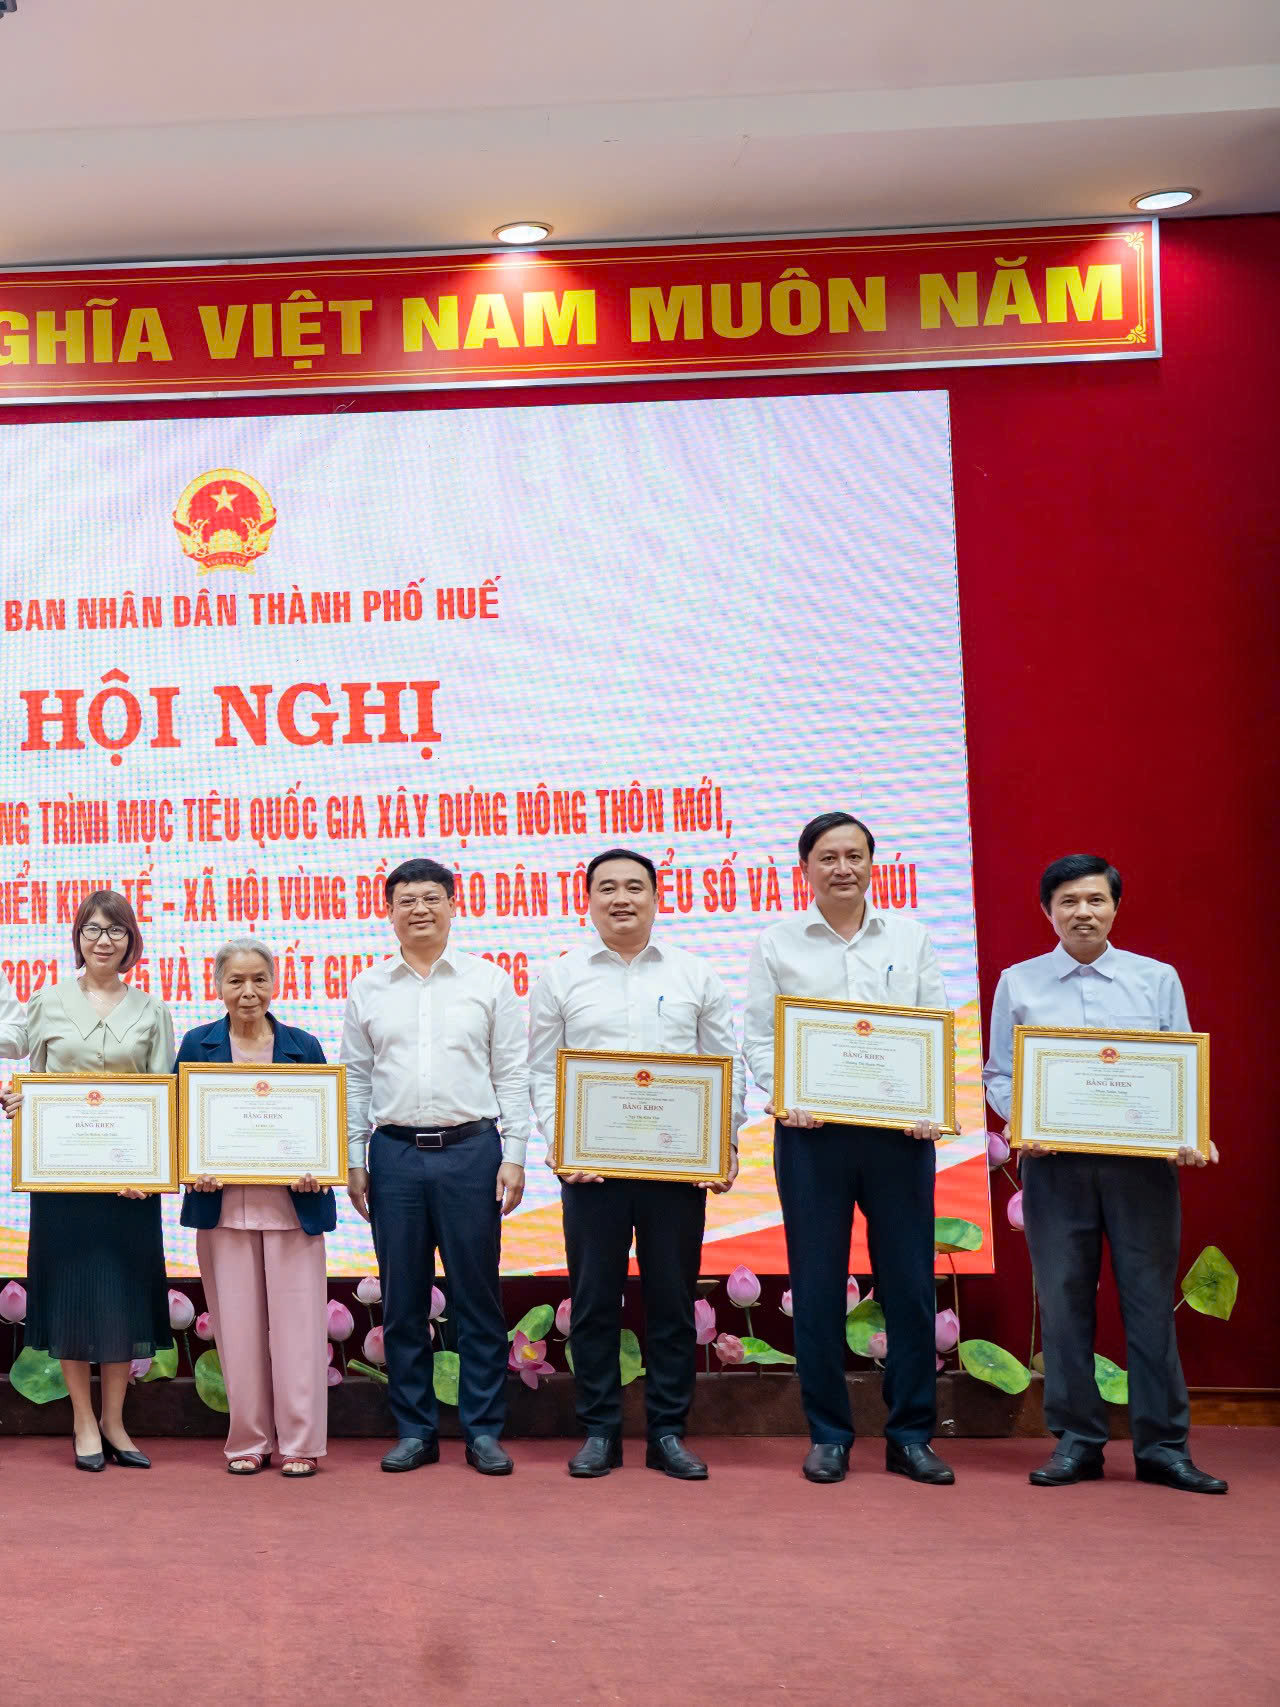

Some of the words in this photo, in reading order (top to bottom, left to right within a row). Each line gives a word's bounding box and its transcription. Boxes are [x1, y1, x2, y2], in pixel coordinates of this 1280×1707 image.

[199, 290, 372, 368] VIỆT
[402, 289, 596, 353] NAM
[630, 268, 886, 342] MUÔN
[920, 256, 1122, 328] NĂM
[6, 600, 65, 631] BAN
[78, 591, 162, 629] NHÂN
[174, 589, 236, 627] DÂN
[249, 585, 350, 625] THÀNH
[364, 578, 424, 622] PHỐ
[437, 576, 501, 620] HUẾ
[20, 668, 180, 766] HỘI
[214, 681, 441, 759] NGHỊ
[39, 793, 108, 844] TRÌNH
[118, 800, 173, 854] MỤC
[184, 790, 239, 841] TIÊU
[251, 782, 317, 848] QUỐC
[327, 798, 366, 839] GIA
[378, 786, 428, 838] XÂY
[439, 786, 507, 848] DỰNG
[517, 783, 586, 835] NÔNG
[596, 781, 663, 833] THÔN
[673, 776, 732, 838] MỚI,
[57, 880, 111, 923] KI
[122, 864, 154, 922] TẾ
[184, 868, 216, 921] XÃ
[228, 869, 268, 932] HỘI
[279, 866, 346, 920] VÙNG
[356, 859, 388, 919] ĐỒ
[453, 863, 485, 917] ÀO
[496, 864, 547, 916] DÂN
[557, 863, 589, 926] TỘ
[703, 852, 737, 912] SỐ
[748, 856, 781, 911] VÀ
[870, 853, 917, 909] NÚI
[160, 947, 191, 1001] VÀ
[204, 958, 217, 1000] Đ
[272, 941, 313, 999] UẤT
[325, 956, 373, 998] GIA
